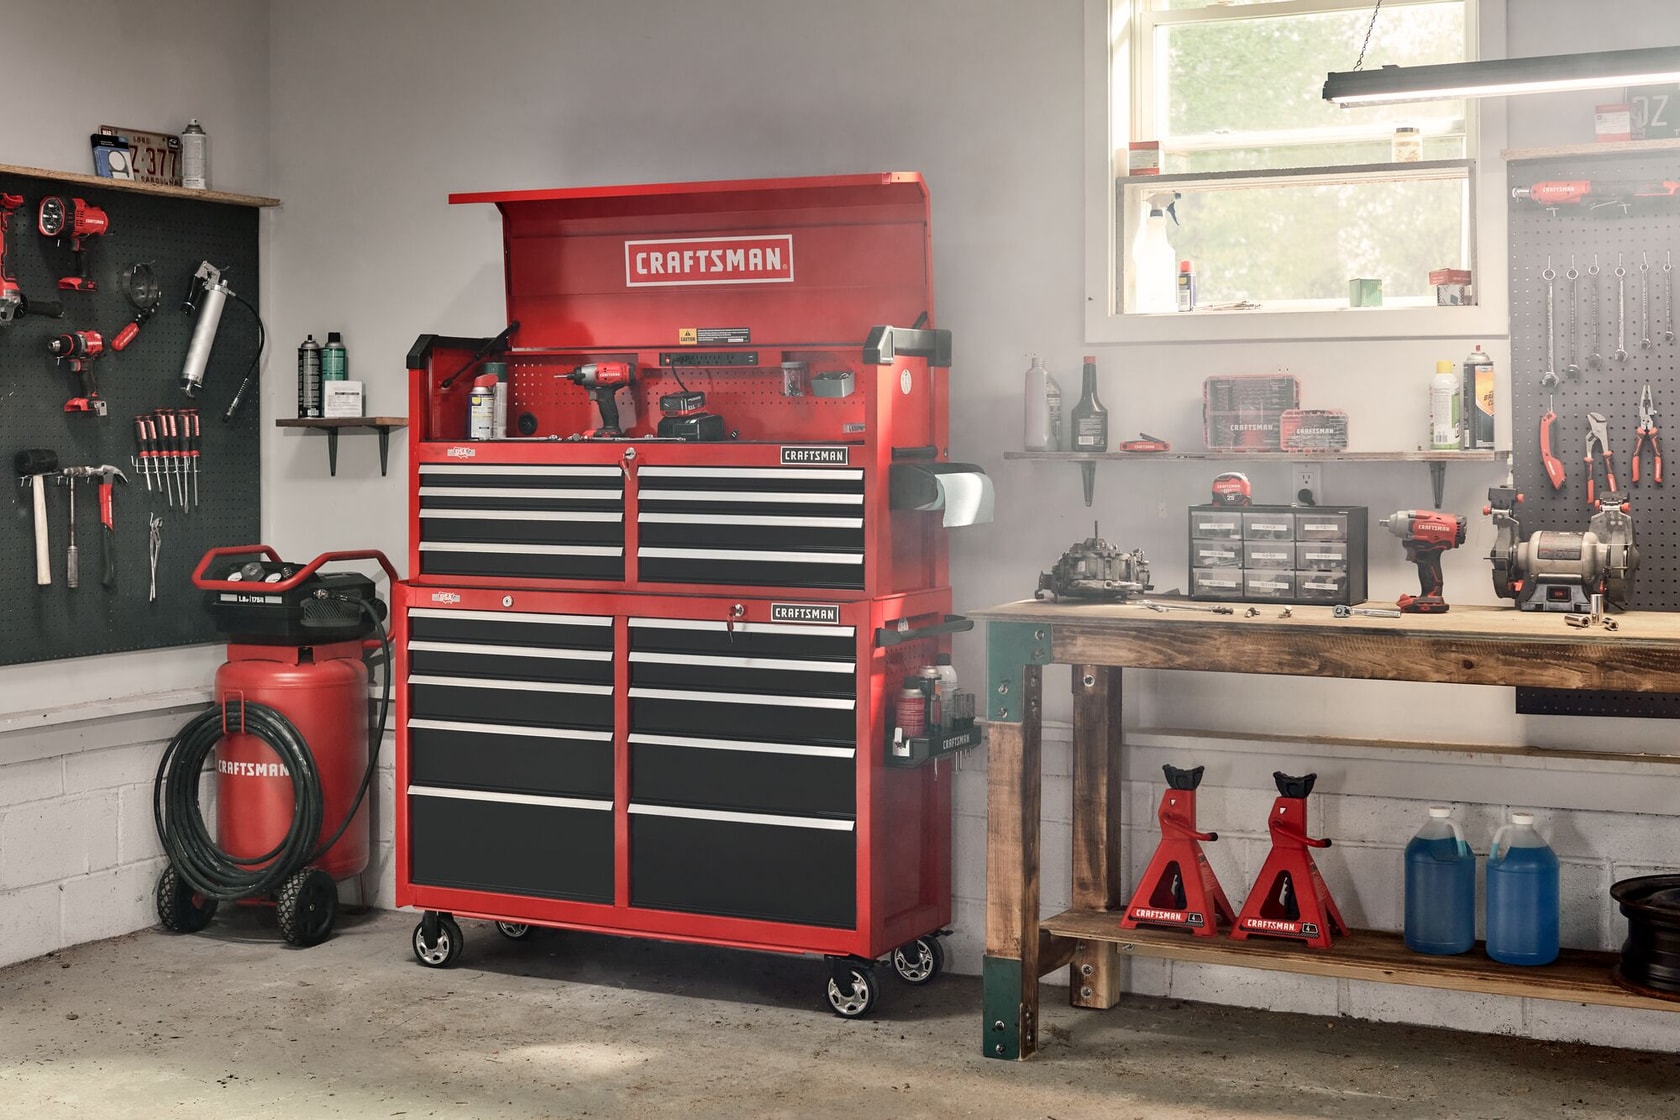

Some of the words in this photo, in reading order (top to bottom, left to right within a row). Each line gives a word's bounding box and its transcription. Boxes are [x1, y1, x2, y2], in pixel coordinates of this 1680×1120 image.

[636, 247, 781, 275] CRAFTSMAN
[1230, 423, 1274, 431] CRAFTSMAN
[785, 450, 844, 462] CRAFTSMAN
[1418, 524, 1450, 532] CRAFTSMAN
[775, 608, 834, 620] CRAFTSMAN
[943, 734, 970, 750] CRAFTSMAN
[218, 760, 290, 777] CRAFTSMAN
[1136, 909, 1182, 920] CRAFTSMAN
[1247, 919, 1295, 931] CRAFTSMAN
